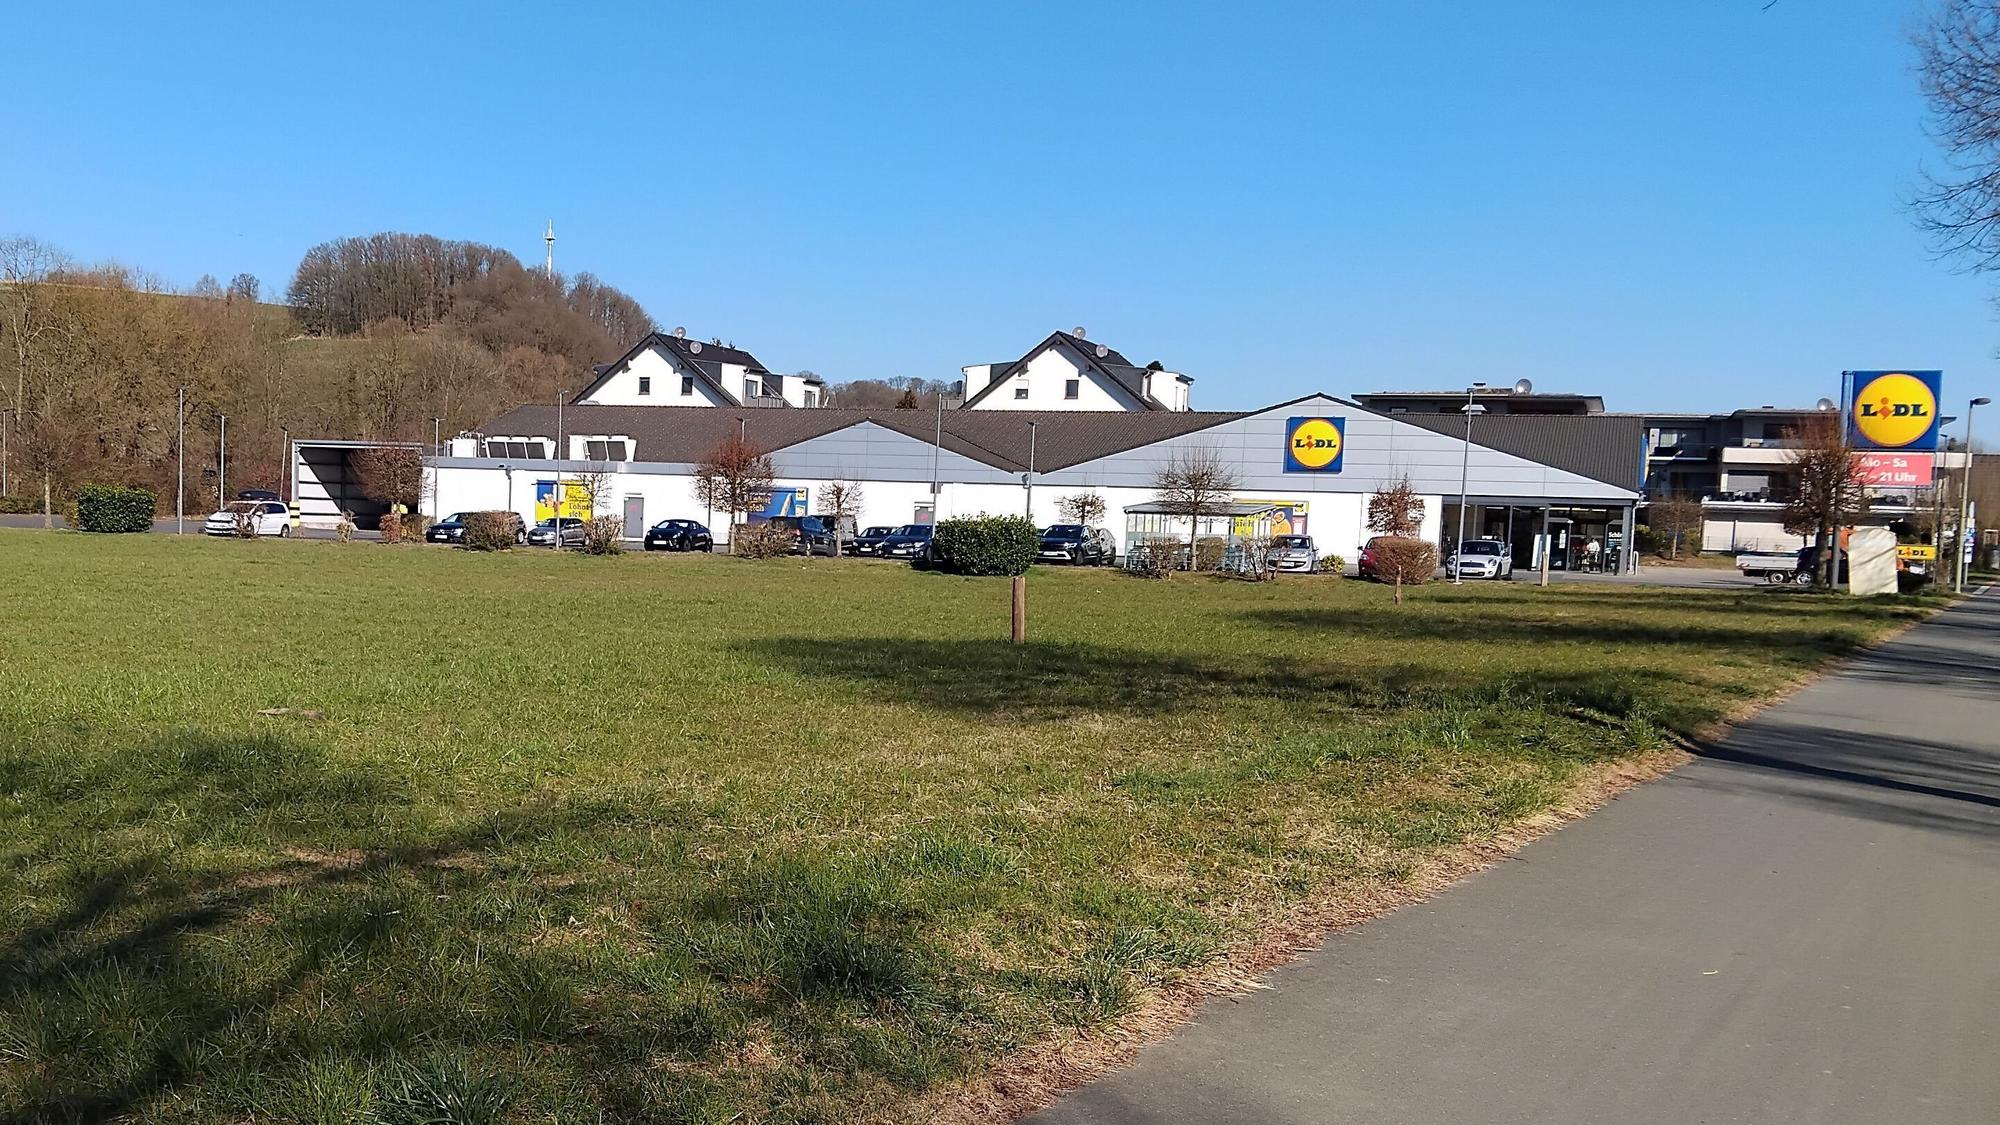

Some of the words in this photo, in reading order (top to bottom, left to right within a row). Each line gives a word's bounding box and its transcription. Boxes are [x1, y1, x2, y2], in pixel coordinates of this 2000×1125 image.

[1893, 457, 1908, 467] Sa
[1879, 472, 1892, 481] 21
[1895, 472, 1917, 482] Uhr
